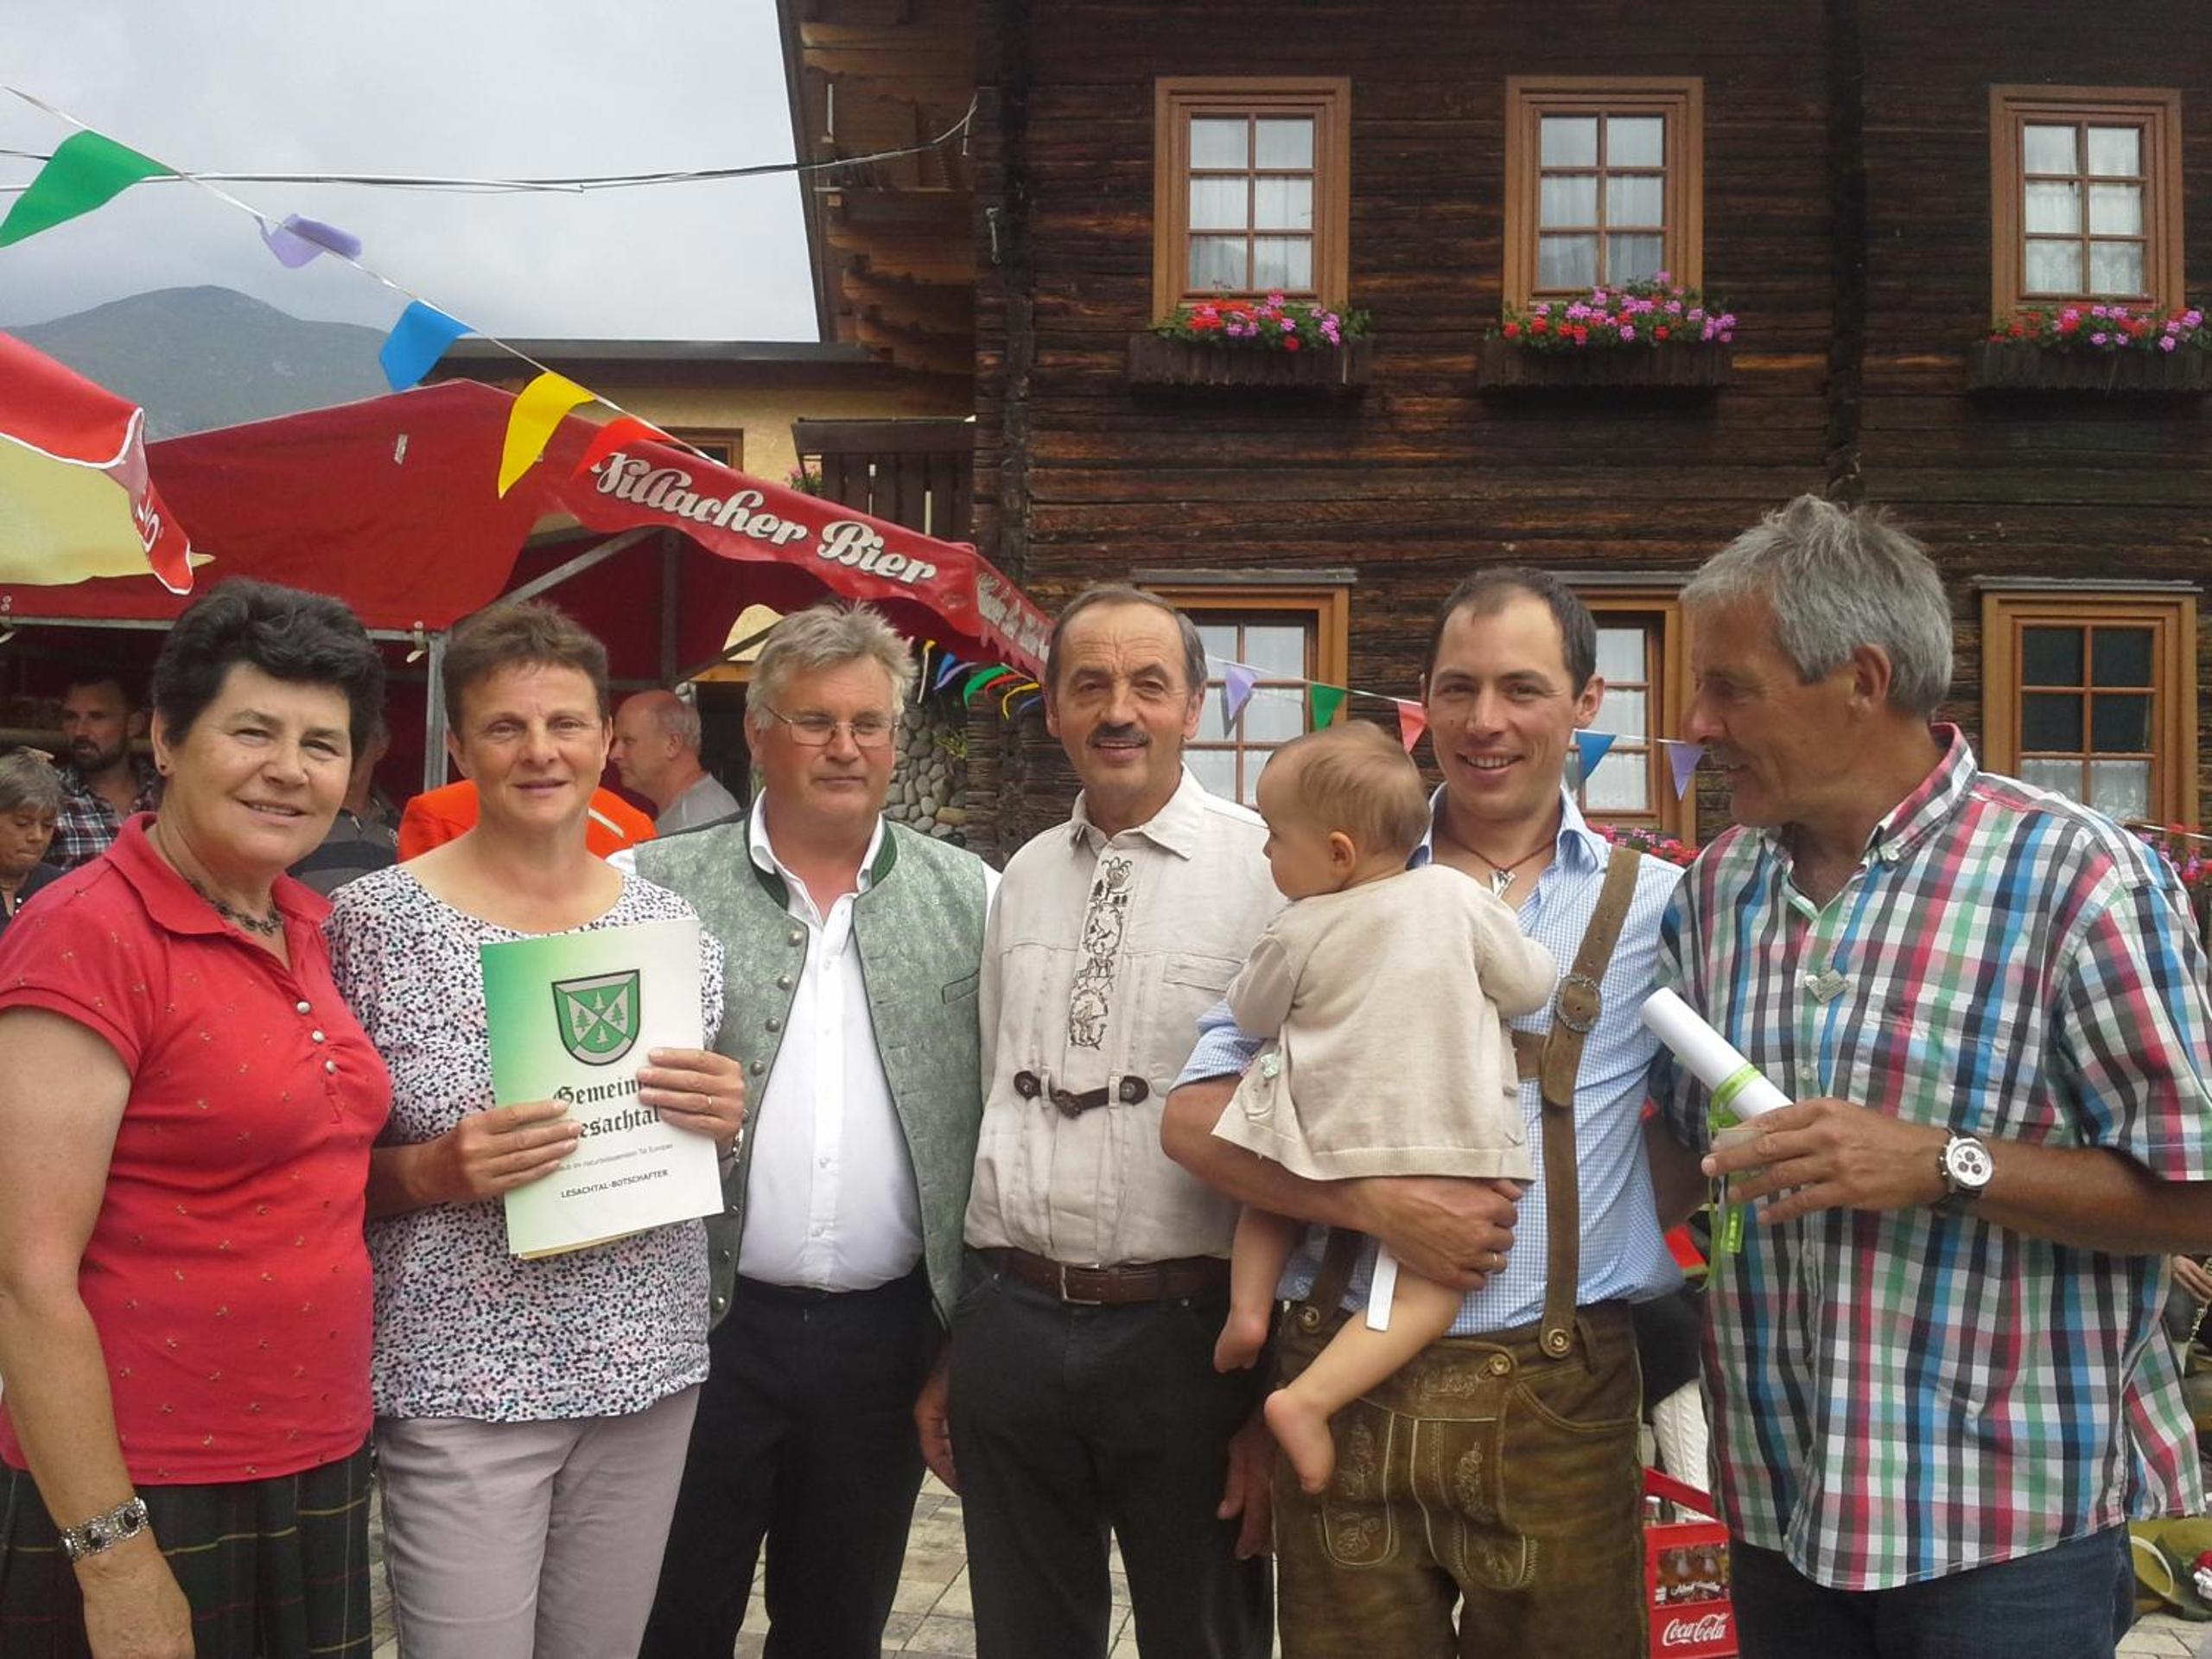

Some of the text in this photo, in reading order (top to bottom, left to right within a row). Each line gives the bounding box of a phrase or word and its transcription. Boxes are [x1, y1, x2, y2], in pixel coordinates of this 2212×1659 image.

[816, 520, 938, 584] Bier
[553, 1077, 644, 1105] Gemein
[579, 1104, 661, 1139] esachtal
[561, 1168, 669, 1198] LESACHTAL-BOTSCHAFTER
